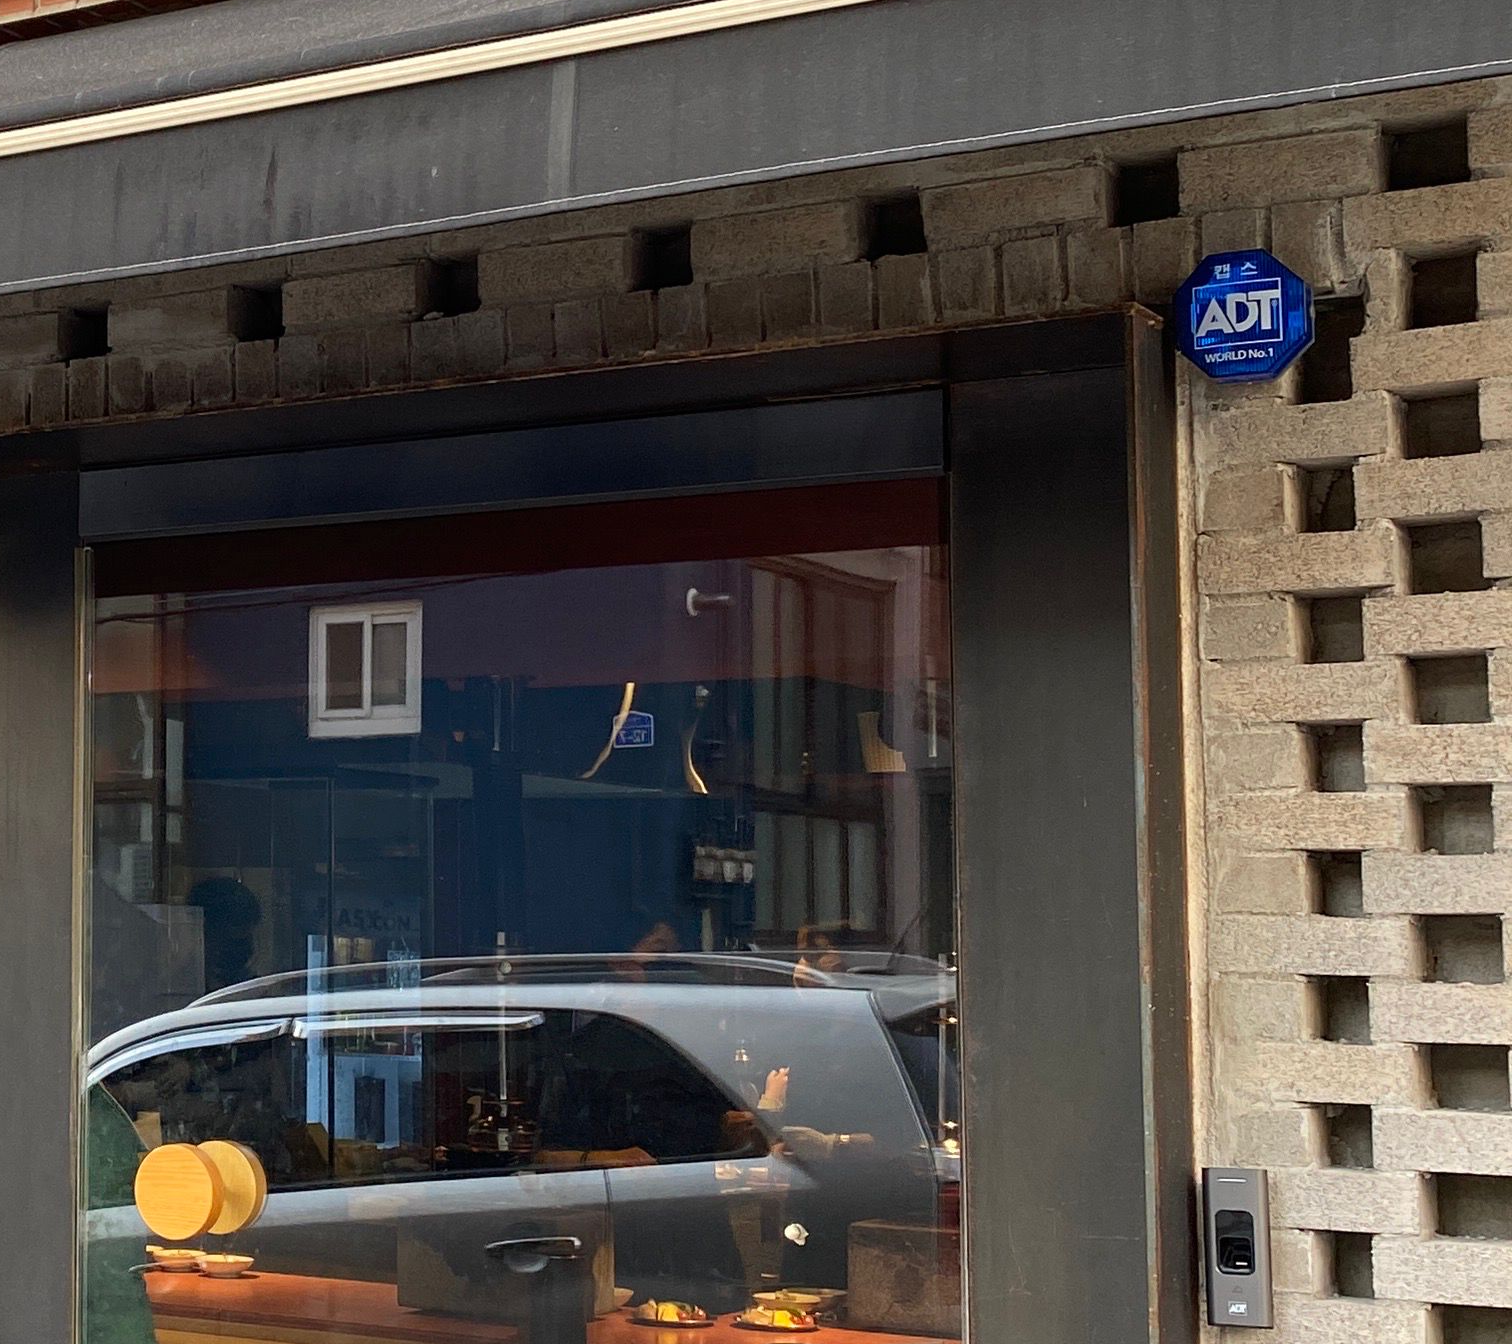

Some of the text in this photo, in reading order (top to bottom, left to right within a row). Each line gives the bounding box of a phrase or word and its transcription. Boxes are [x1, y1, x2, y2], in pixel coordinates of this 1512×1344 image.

[1196, 289, 1280, 337] ADT
[1204, 347, 1274, 363] WORLD No.1
[1229, 1303, 1247, 1314] ADT
